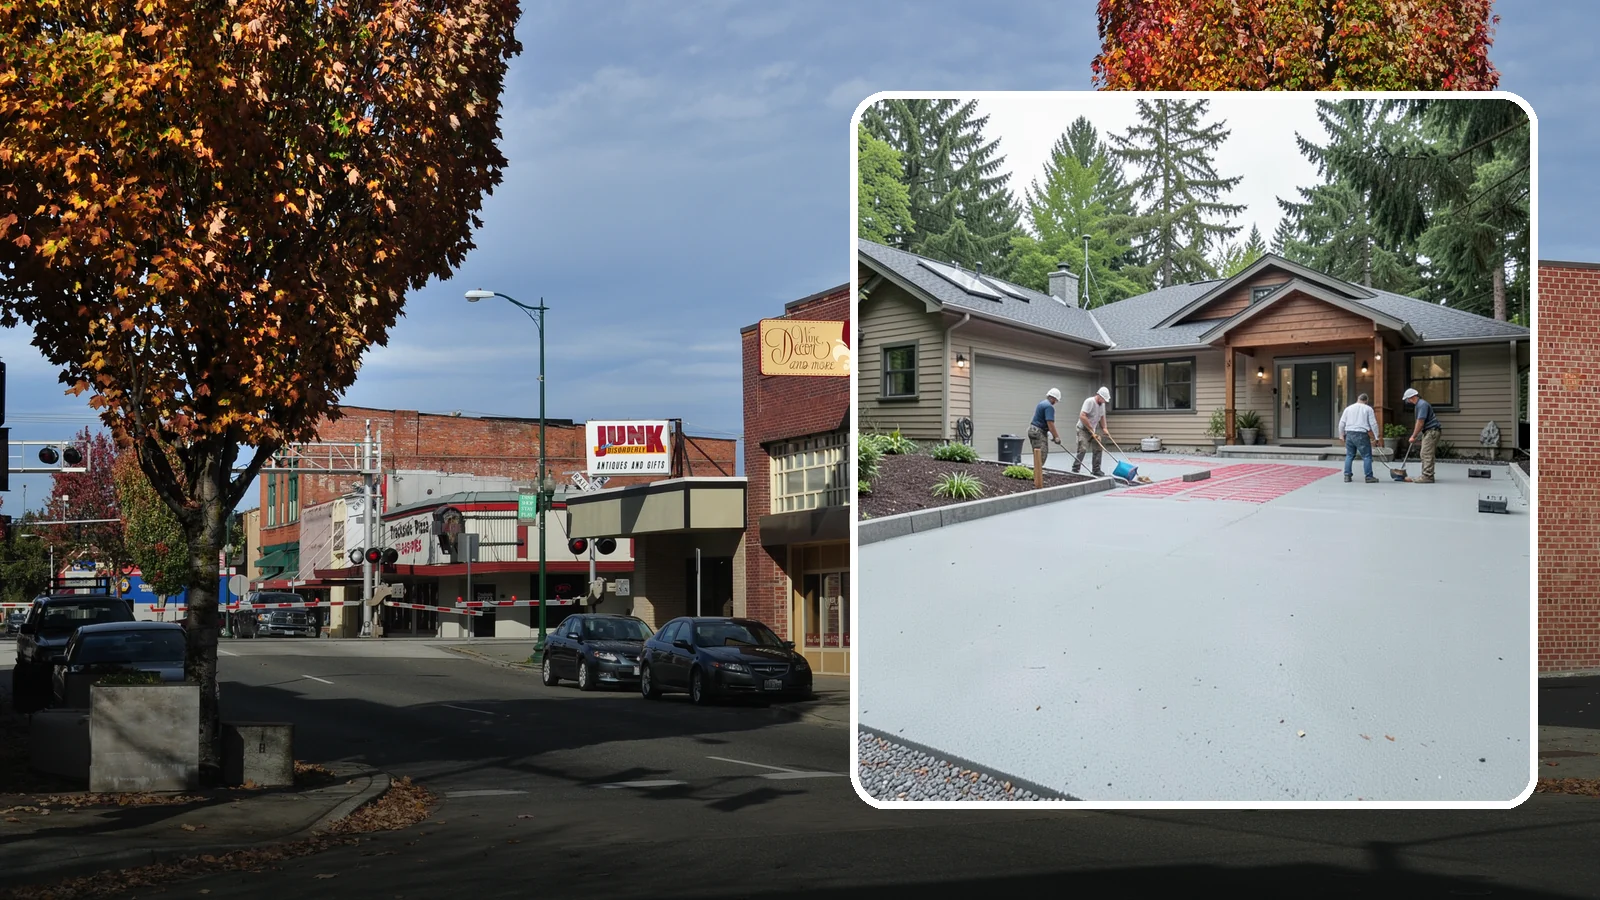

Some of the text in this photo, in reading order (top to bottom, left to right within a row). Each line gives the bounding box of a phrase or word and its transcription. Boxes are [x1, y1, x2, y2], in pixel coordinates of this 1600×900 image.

[595, 425, 665, 457] JUNK
[607, 446, 646, 454] DISORDERLY
[597, 460, 665, 470] ANTIQUES AND GIFTS
[390, 519, 429, 540] Trackside Pizza
